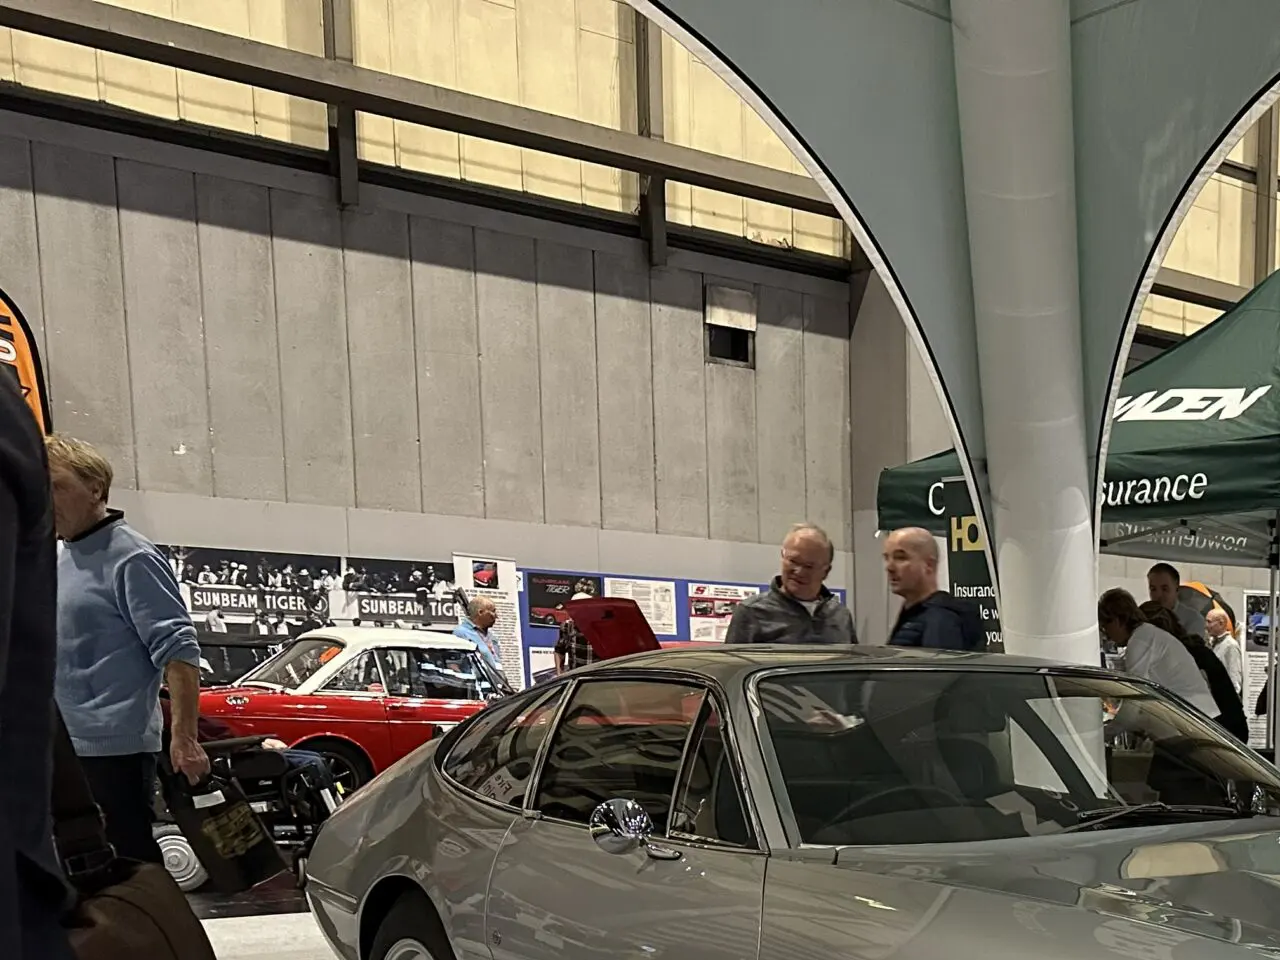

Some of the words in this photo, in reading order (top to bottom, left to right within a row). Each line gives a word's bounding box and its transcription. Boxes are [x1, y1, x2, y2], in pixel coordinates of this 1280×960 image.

[1112, 385, 1272, 422] WDEN
[1100, 472, 1208, 507] surance
[953, 582, 997, 598] Insuranc
[193, 591, 258, 609] SUNBEAM
[264, 595, 307, 611] TIGER
[360, 598, 424, 616] SUNBEAM
